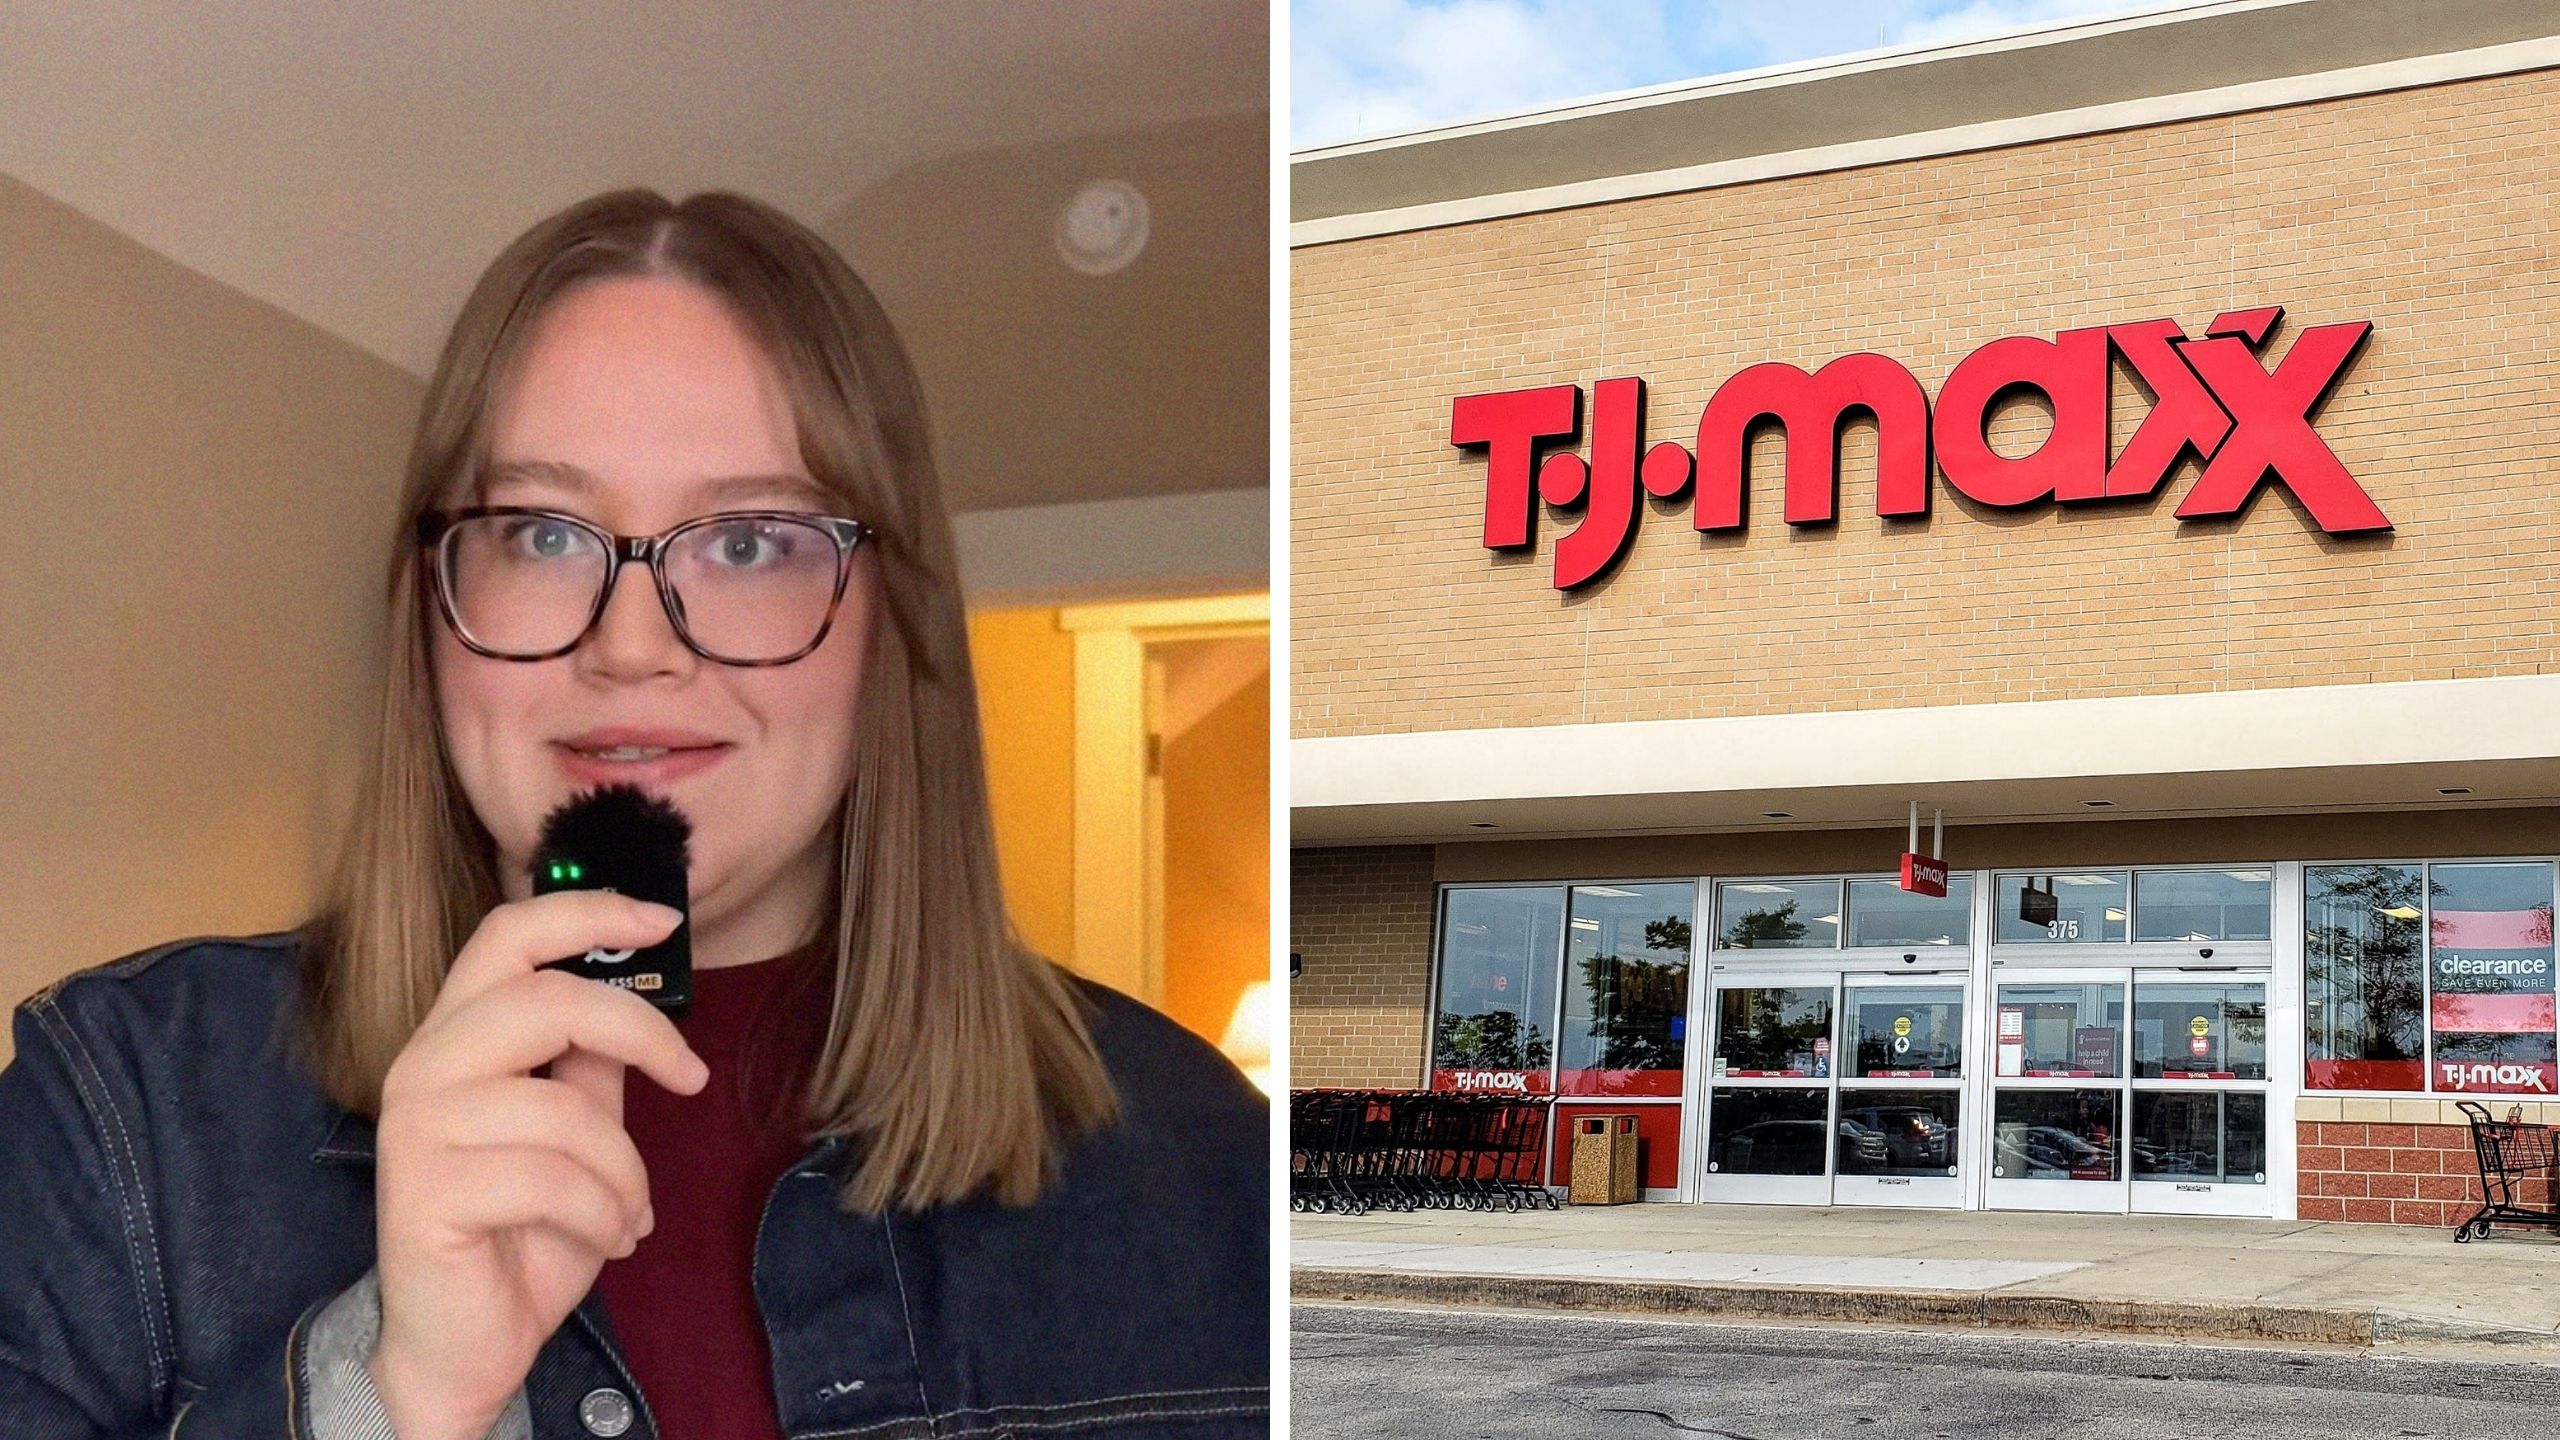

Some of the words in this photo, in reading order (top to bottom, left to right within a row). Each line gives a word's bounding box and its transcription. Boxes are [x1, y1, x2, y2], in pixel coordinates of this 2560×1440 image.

[2047, 920, 2079, 939] 375
[2440, 954, 2547, 975] clearance
[637, 975, 660, 987] ME
[2441, 979, 2472, 988] SAVE
[2476, 979, 2507, 988] EVEN
[2512, 978, 2546, 988] MORE
[2079, 1048, 2091, 1058] help
[2095, 1048, 2109, 1057] child
